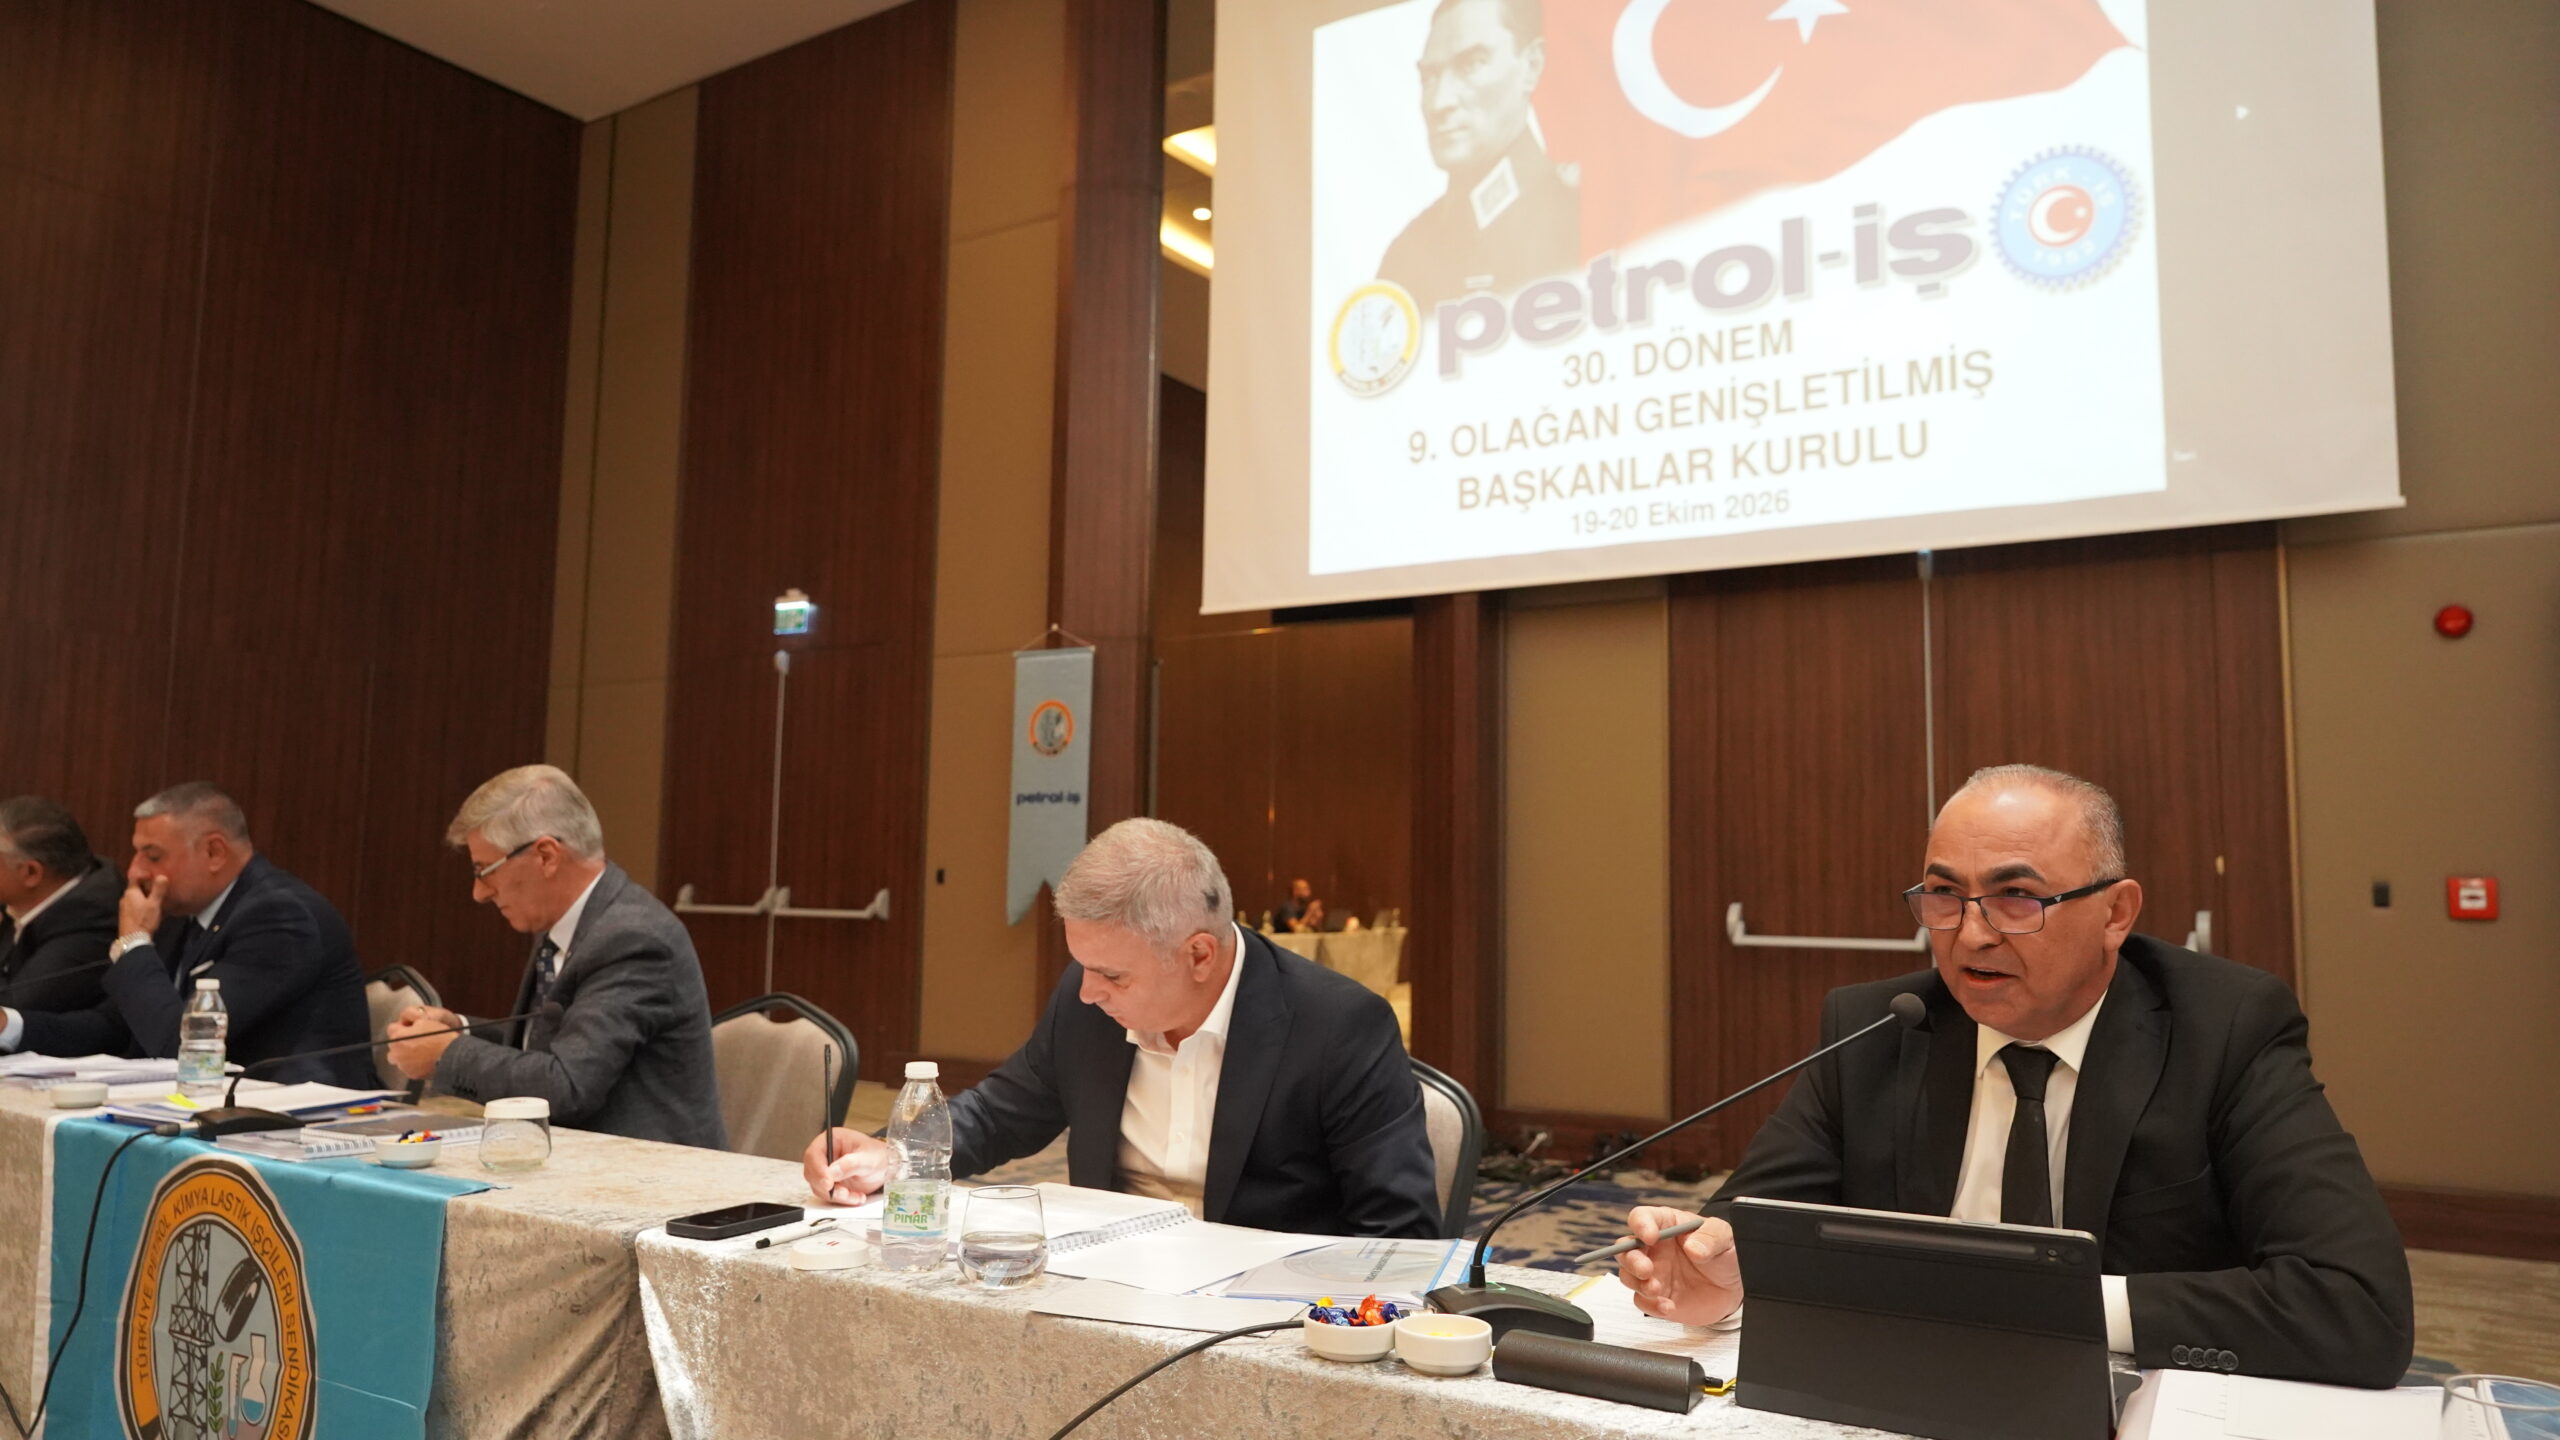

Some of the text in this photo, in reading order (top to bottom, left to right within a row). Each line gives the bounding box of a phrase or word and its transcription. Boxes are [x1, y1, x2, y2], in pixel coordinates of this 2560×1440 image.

[1437, 202, 1977, 377] petrol-iş
[1563, 319, 1793, 388] 30. DÖNEM
[1408, 344, 1994, 464] 9. OLAĞAN GENİŞLETİLMİŞ
[1458, 420, 1928, 512] BAŞKANLAR KURULU
[1571, 489, 1790, 535] 19-20 Ekim 2026
[173, 1187, 208, 1218] KİMYA
[210, 1187, 252, 1228] LASTİK
